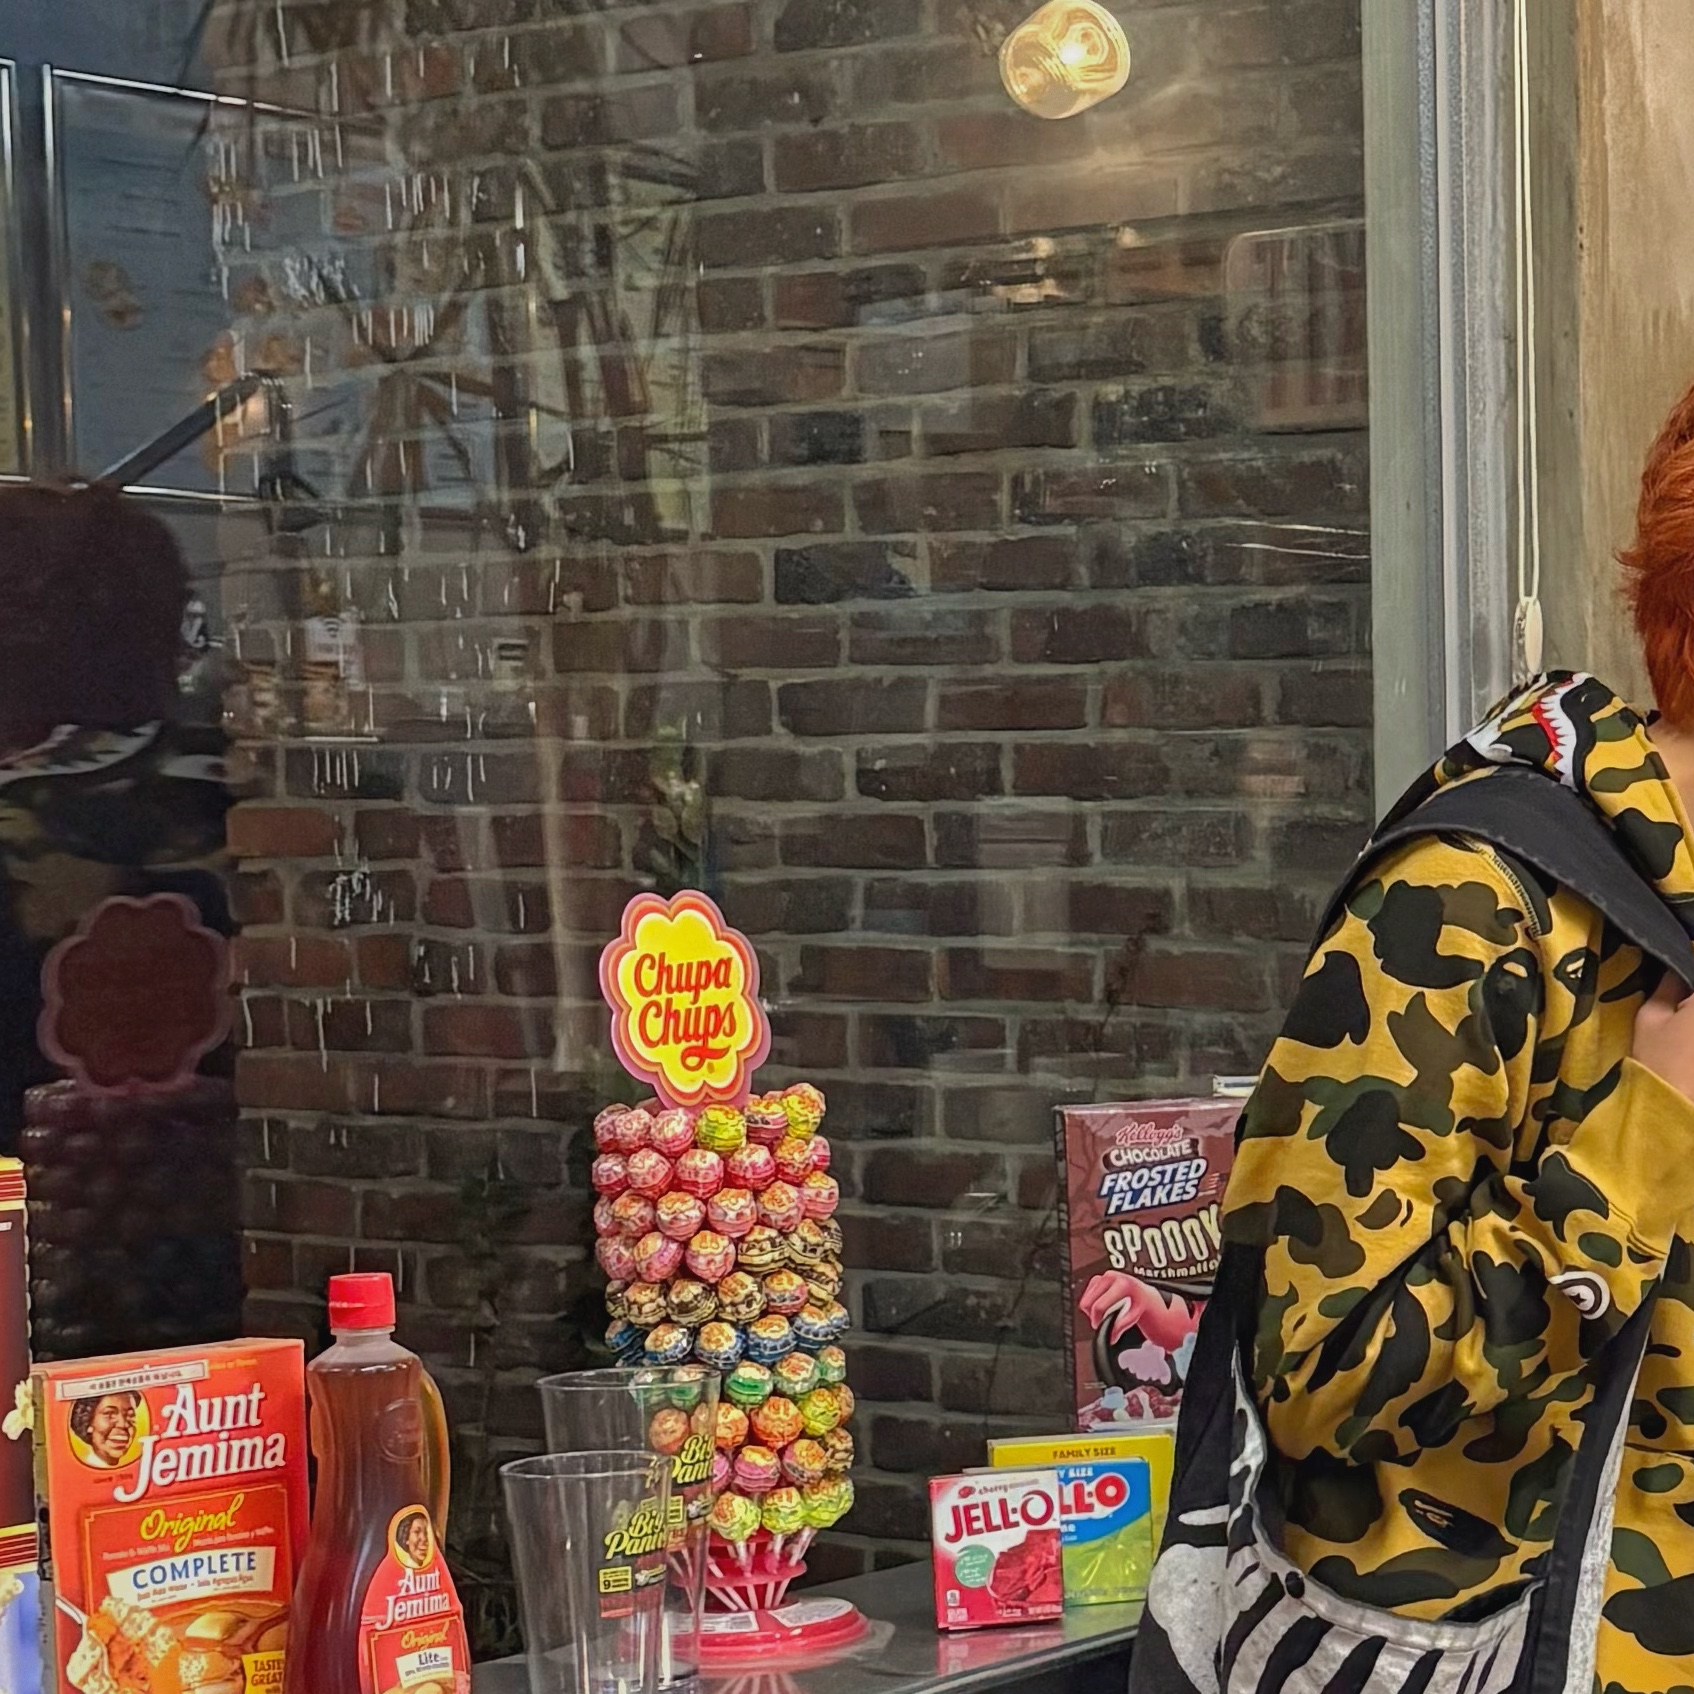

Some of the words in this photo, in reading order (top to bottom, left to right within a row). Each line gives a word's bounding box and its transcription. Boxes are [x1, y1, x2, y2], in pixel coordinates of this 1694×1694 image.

[633, 951, 734, 1005] Chupa
[638, 997, 737, 1072] Chups
[1115, 1121, 1185, 1146] Kellogg's
[1108, 1139, 1194, 1168] CHOCOLATE
[1100, 1158, 1208, 1197] FROSTED
[1107, 1181, 1199, 1216] FLAKES
[1133, 1253, 1222, 1279] Marshmallo
[161, 1381, 266, 1439] Aunt
[113, 1431, 286, 1503] Jemima
[1052, 1447, 1092, 1460] FAMILY
[1093, 1446, 1117, 1457] SIZE
[1059, 1472, 1129, 1517] LL-O
[140, 1492, 245, 1553] Original
[628, 1510, 665, 1538] Big
[132, 1551, 256, 1590] COMPLETE
[397, 1567, 441, 1597] Aunt
[603, 1579, 612, 1590] 9
[374, 1592, 450, 1631] Jemima
[252, 1659, 284, 1673] TASTE
[418, 1651, 440, 1667] Lite
